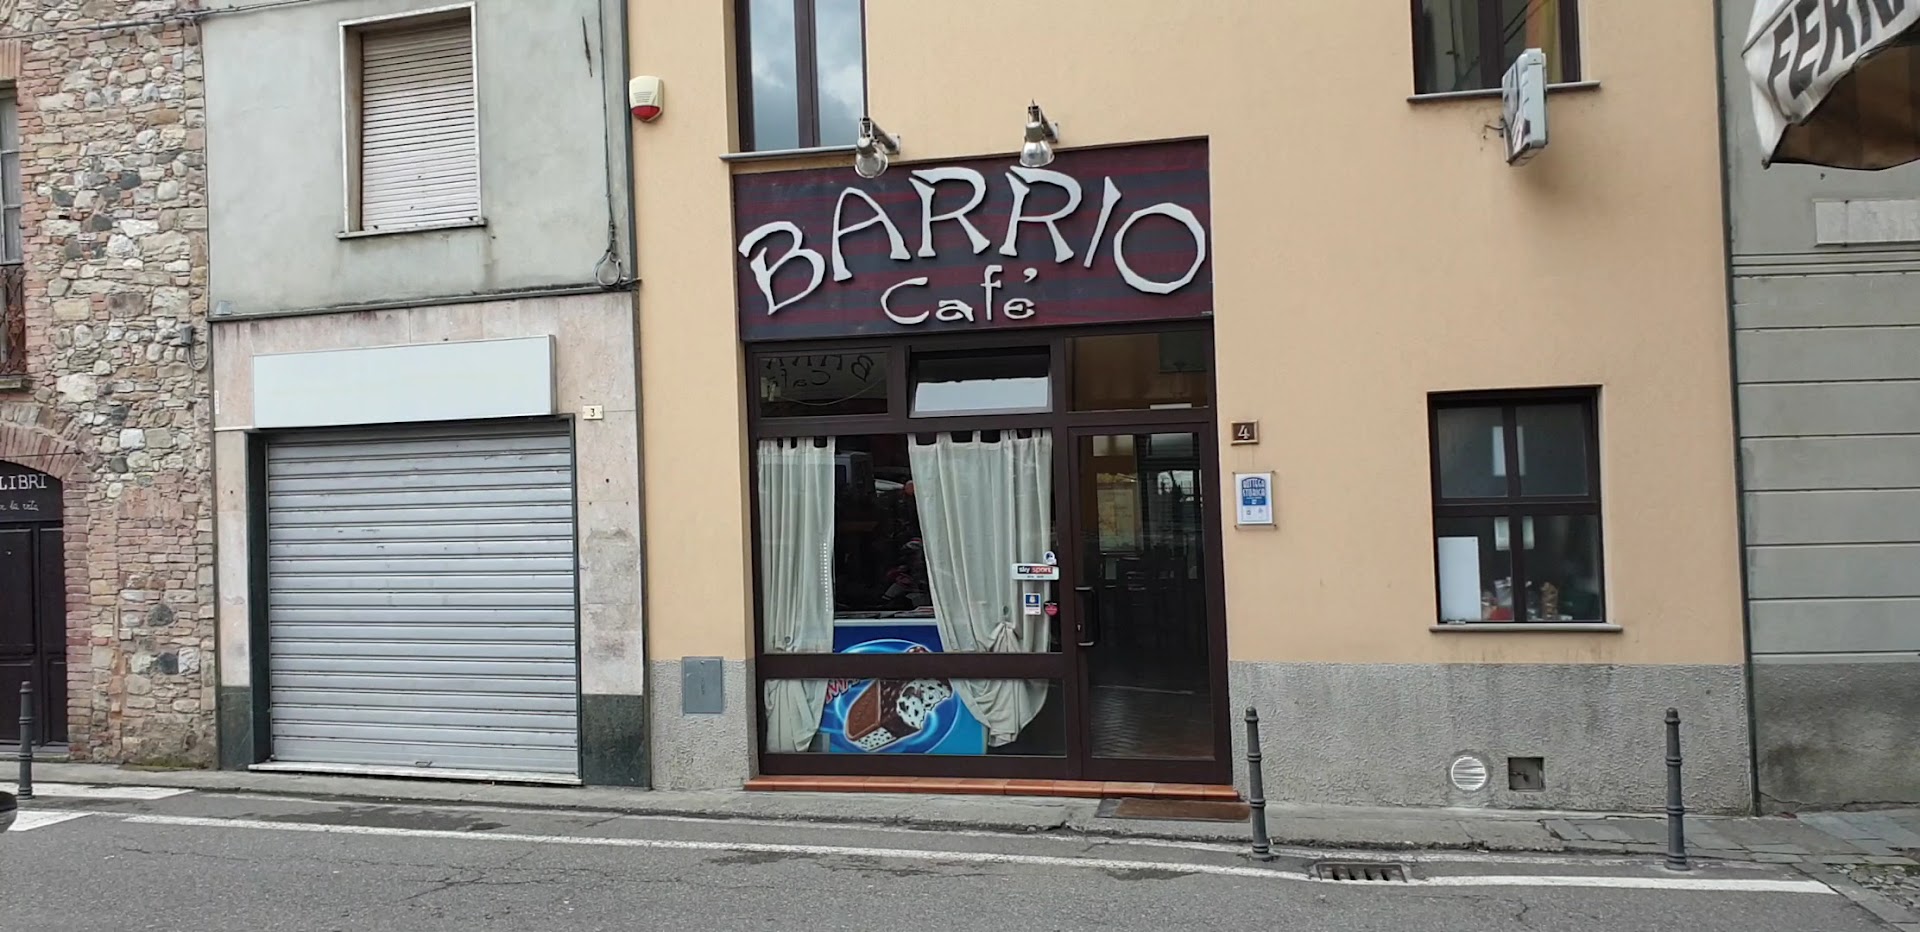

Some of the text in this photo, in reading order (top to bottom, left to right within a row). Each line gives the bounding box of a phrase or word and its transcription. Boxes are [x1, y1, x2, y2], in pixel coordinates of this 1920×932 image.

[739, 165, 1206, 315] BARRIO
[590, 408, 595, 417] 3
[1238, 425, 1250, 439] 4
